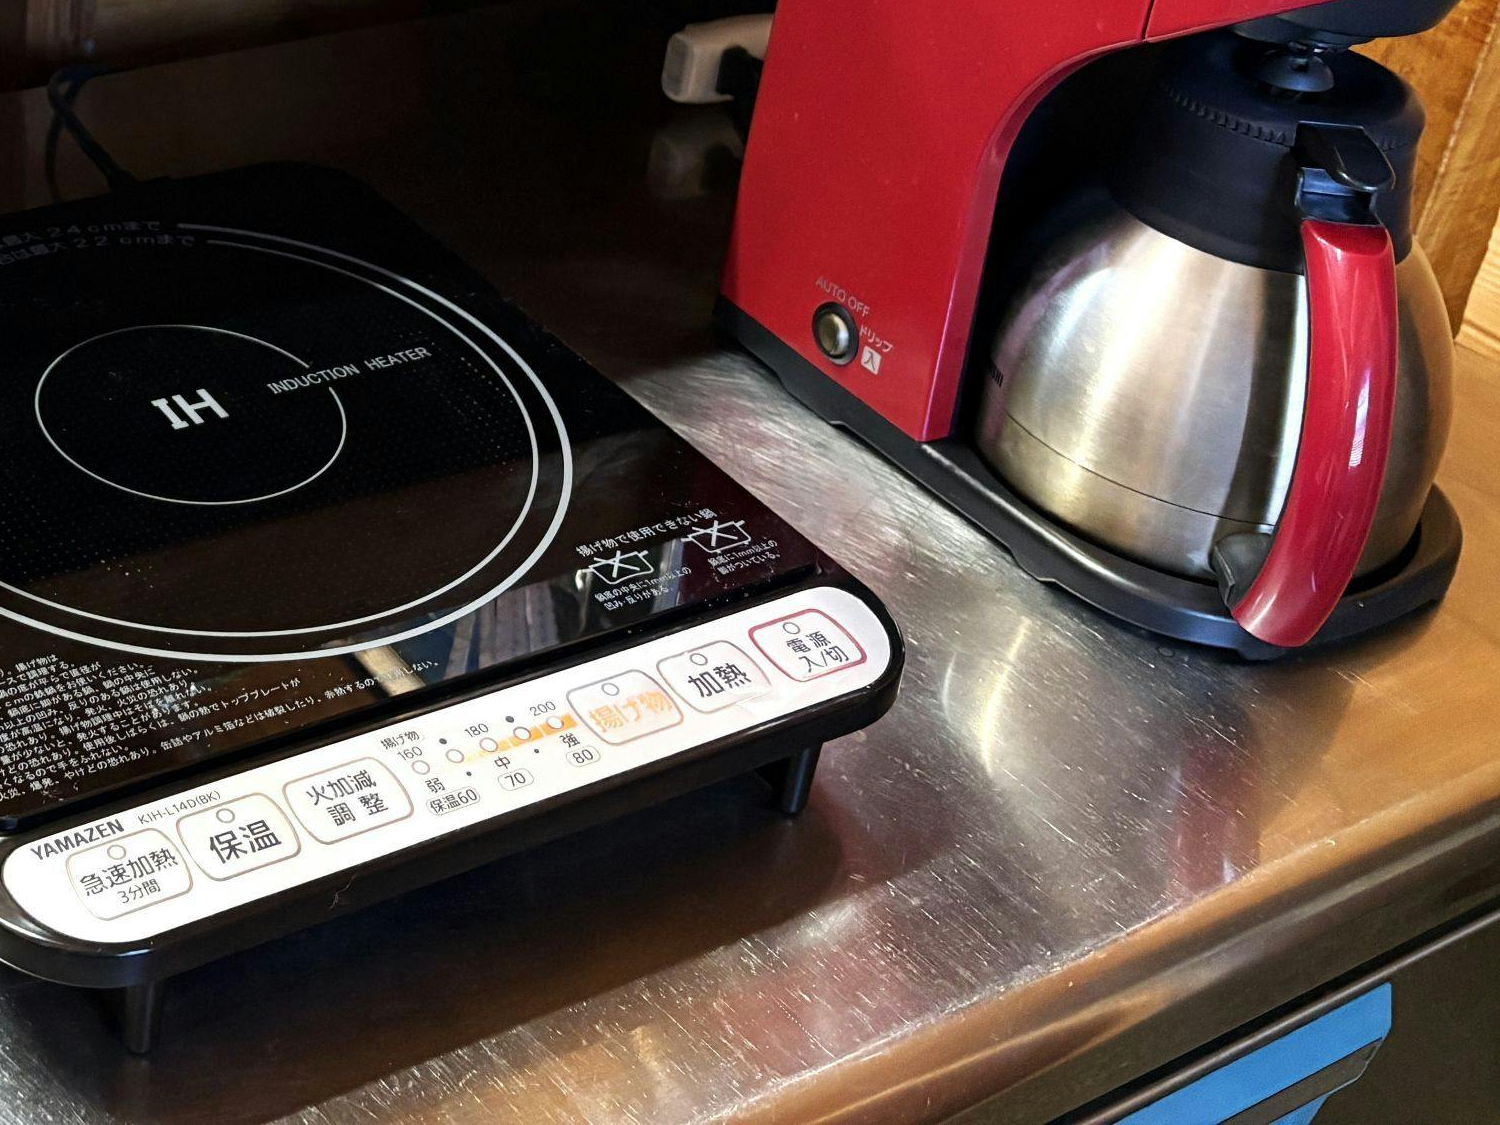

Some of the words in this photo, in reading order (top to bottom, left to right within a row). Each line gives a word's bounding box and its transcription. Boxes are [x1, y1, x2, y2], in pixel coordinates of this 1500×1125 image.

[815, 276, 846, 302] AUTO
[848, 296, 870, 317] OFF
[860, 325, 893, 353] ドリップ
[266, 363, 361, 395] INDUCTION
[363, 346, 432, 372] HEATER
[150, 388, 230, 430] IH
[576, 508, 718, 558] 揚げ物で使用できない鍋
[785, 632, 826, 655] 電源
[799, 647, 850, 674] 入/切
[688, 664, 753, 700] 加熱
[529, 699, 557, 717] 200
[587, 689, 675, 735] 揚げ物
[380, 728, 420, 752] 揚げ物
[464, 723, 488, 738] 180
[560, 732, 581, 750] 強
[397, 746, 424, 762] 160
[495, 754, 511, 772] 中
[572, 748, 594, 765] 80
[307, 769, 378, 806] 火加減
[426, 776, 446, 795] 弱
[505, 772, 527, 789] 70
[137, 789, 221, 826] KIH-L14D(BK)
[327, 794, 389, 828] 調整
[429, 787, 478, 814] 保温60
[30, 818, 125, 862] YAMAZEN
[209, 819, 283, 864] 保温
[79, 847, 179, 897] 急速加熱
[117, 878, 162, 905] 3分間
